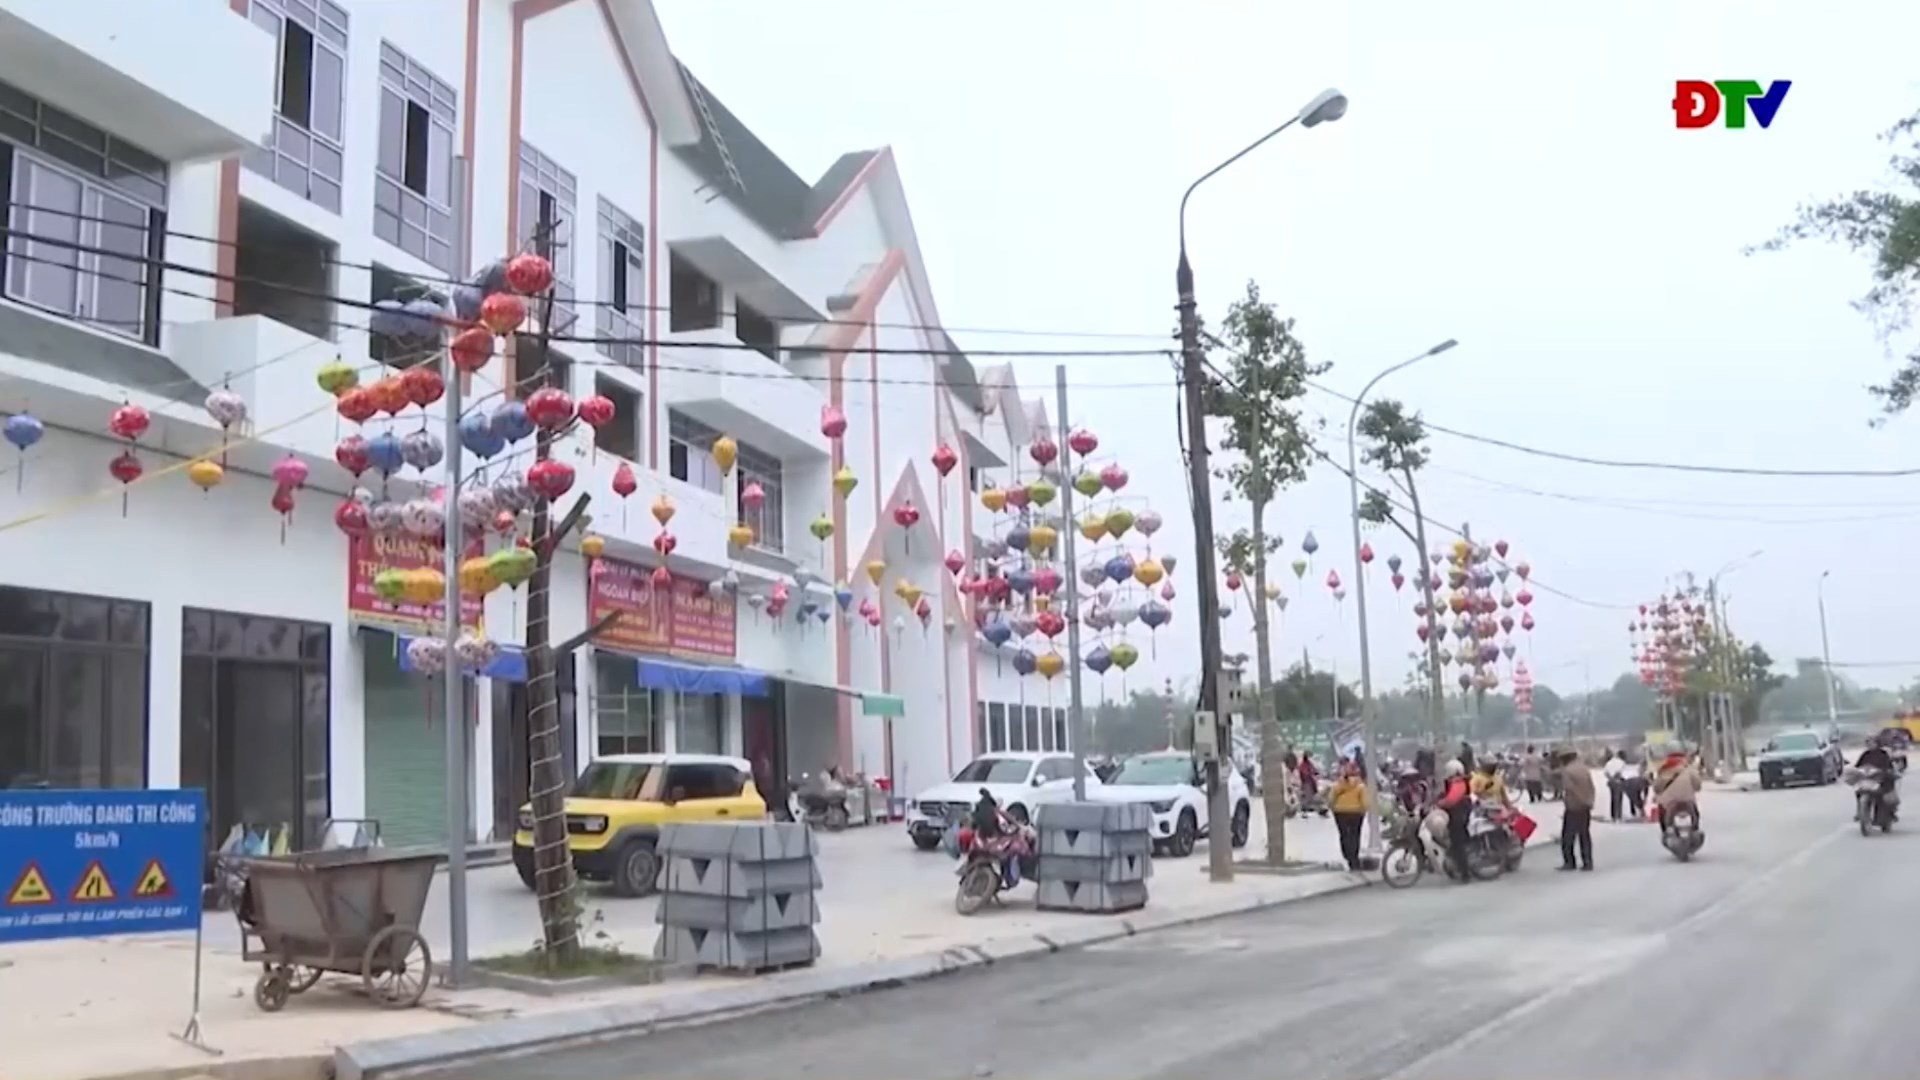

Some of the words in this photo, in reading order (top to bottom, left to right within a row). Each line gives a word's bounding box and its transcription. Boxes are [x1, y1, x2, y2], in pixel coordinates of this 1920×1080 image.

[137, 803, 158, 824] THI
[160, 800, 196, 824] CÔNG
[75, 830, 120, 849] 5km/h
